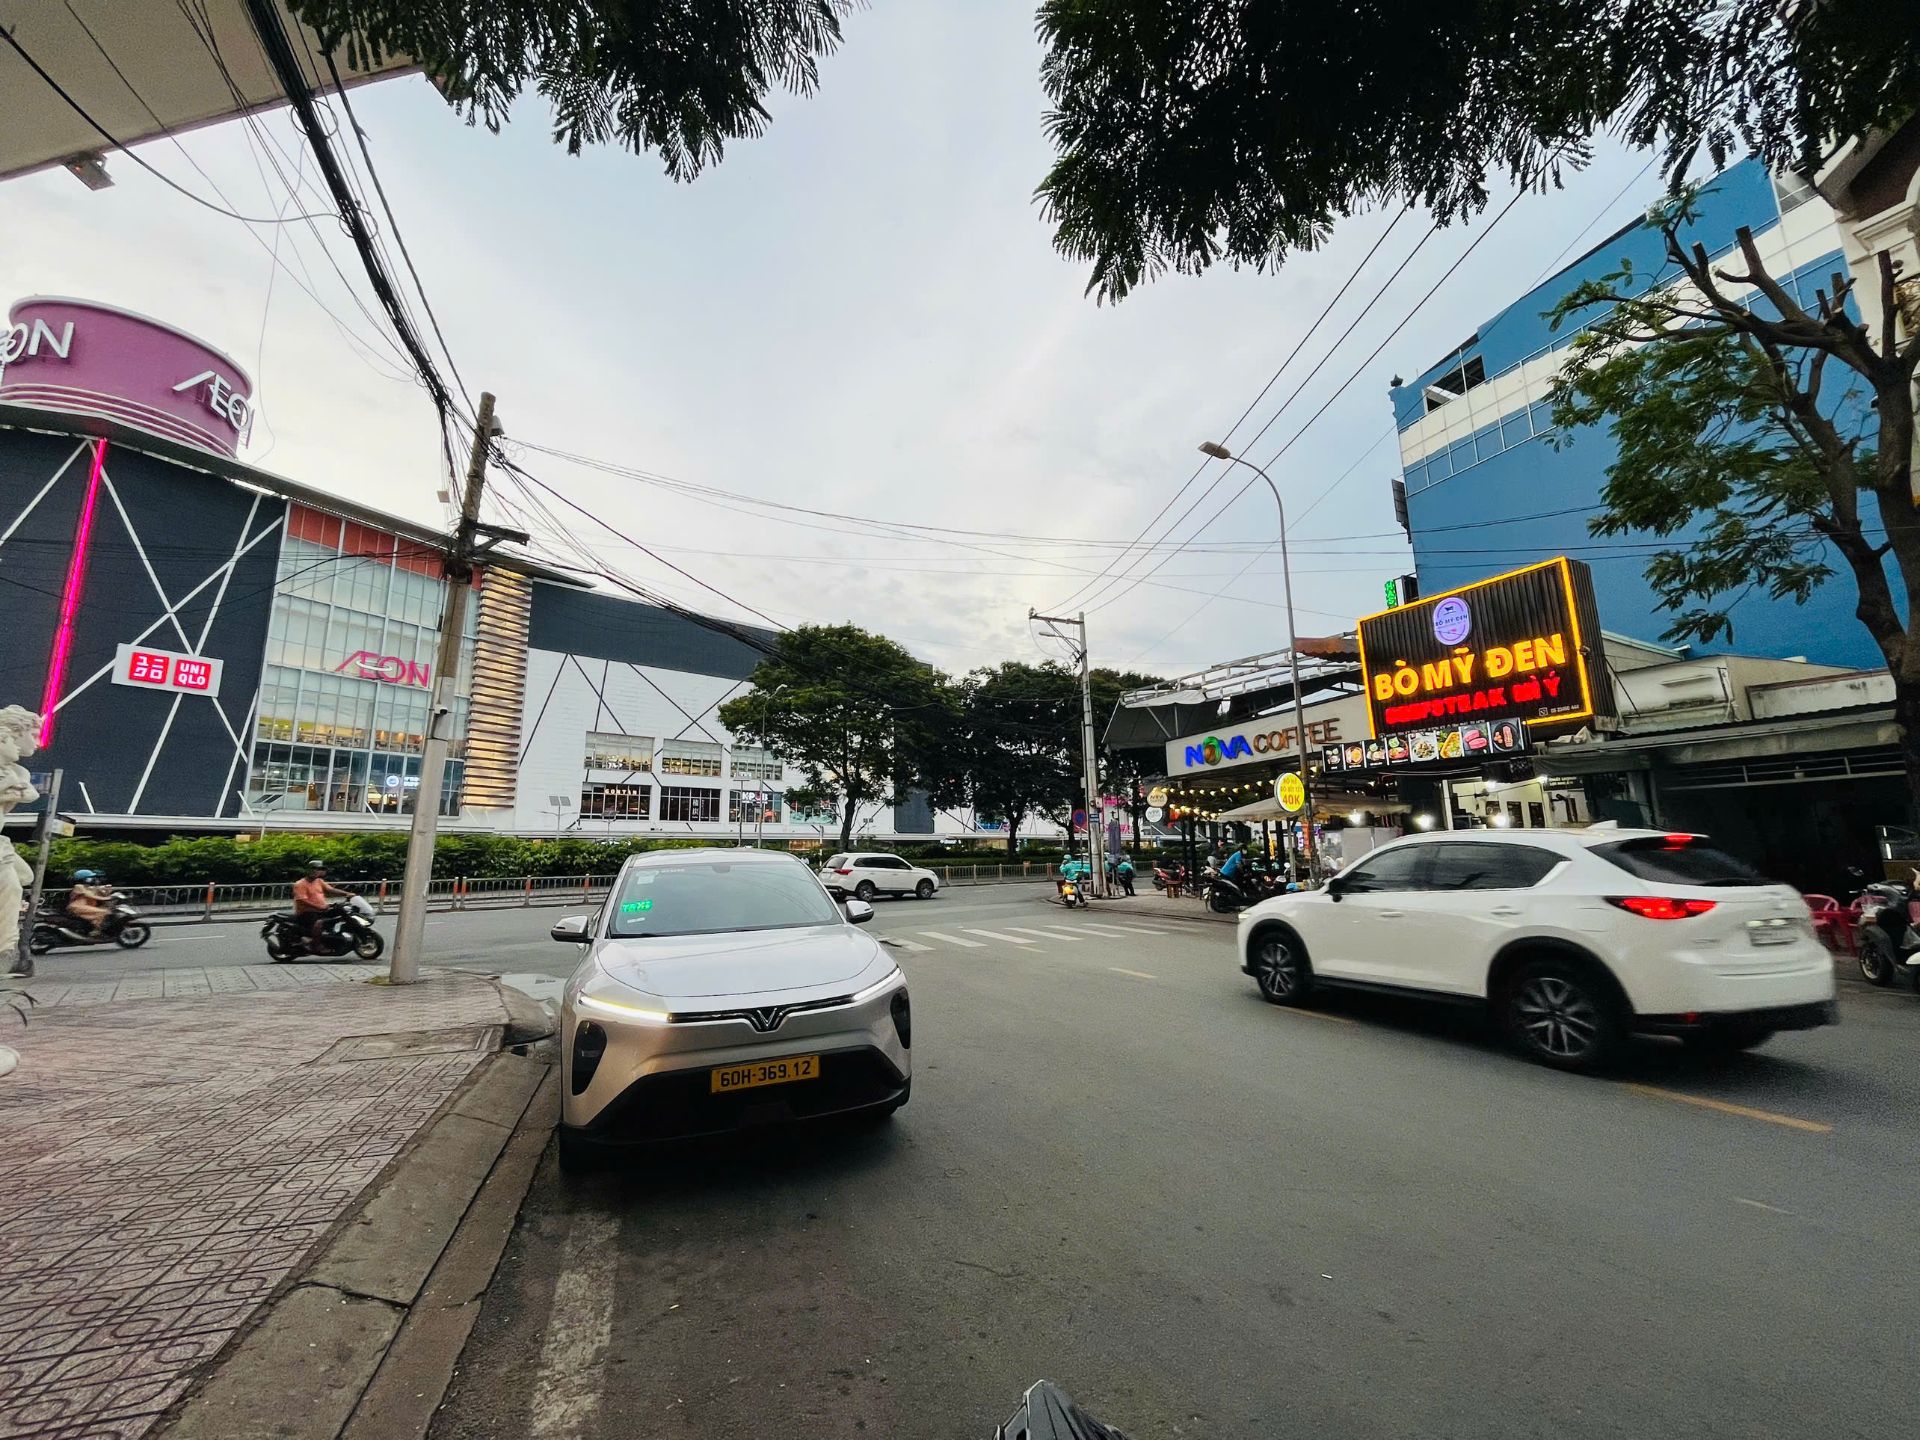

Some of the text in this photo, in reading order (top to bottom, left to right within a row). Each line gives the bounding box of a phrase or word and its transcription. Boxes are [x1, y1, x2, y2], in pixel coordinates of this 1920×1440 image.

[136, 655, 165, 669] ユニ
[180, 662, 206, 675] UNI
[1374, 633, 1566, 701] BÒ MỸ ĐEN
[133, 667, 164, 680] クロ
[178, 673, 206, 686] QLO
[1543, 670, 1561, 698] Ý
[1185, 734, 1254, 768] NOVA
[1282, 794, 1301, 805] 40K
